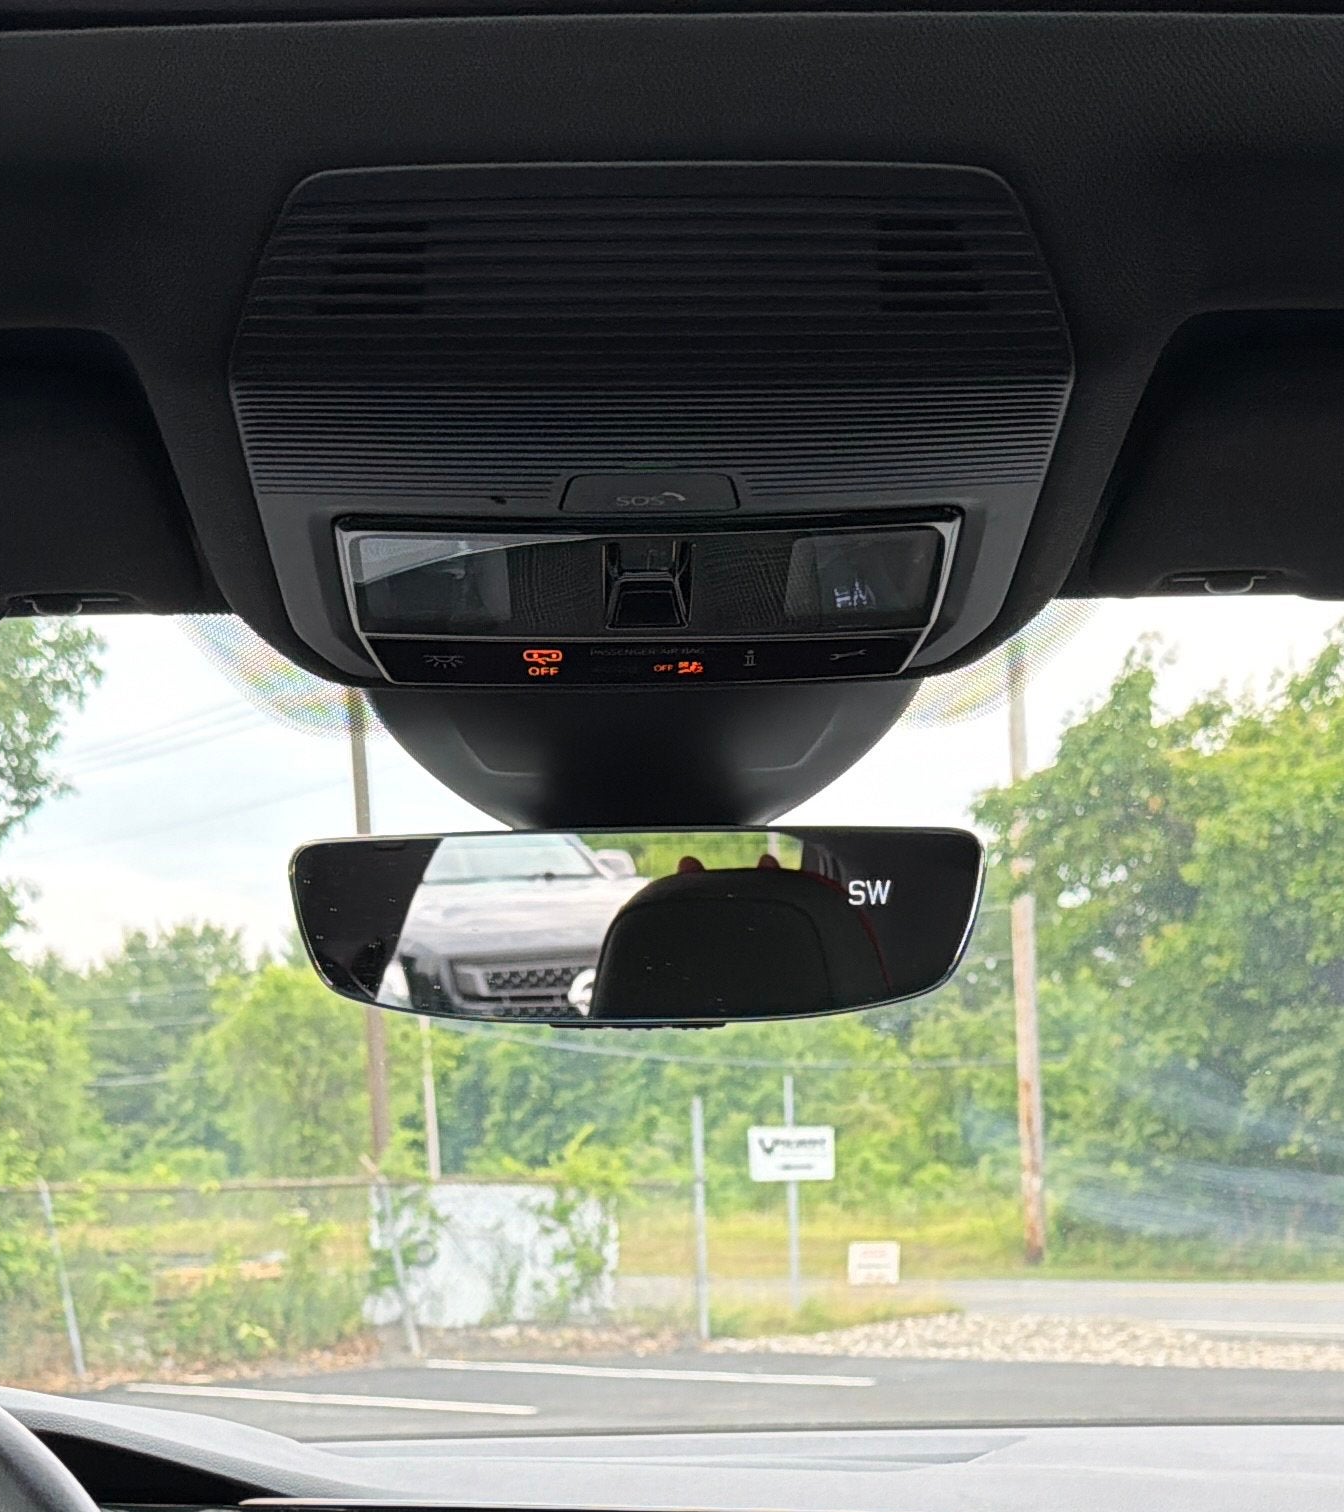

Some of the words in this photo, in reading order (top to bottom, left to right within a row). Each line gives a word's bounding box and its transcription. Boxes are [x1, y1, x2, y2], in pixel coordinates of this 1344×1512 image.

[616, 495, 665, 506] SOS
[528, 666, 559, 677] OFF
[653, 663, 673, 672] OFF
[848, 879, 891, 906] SW
